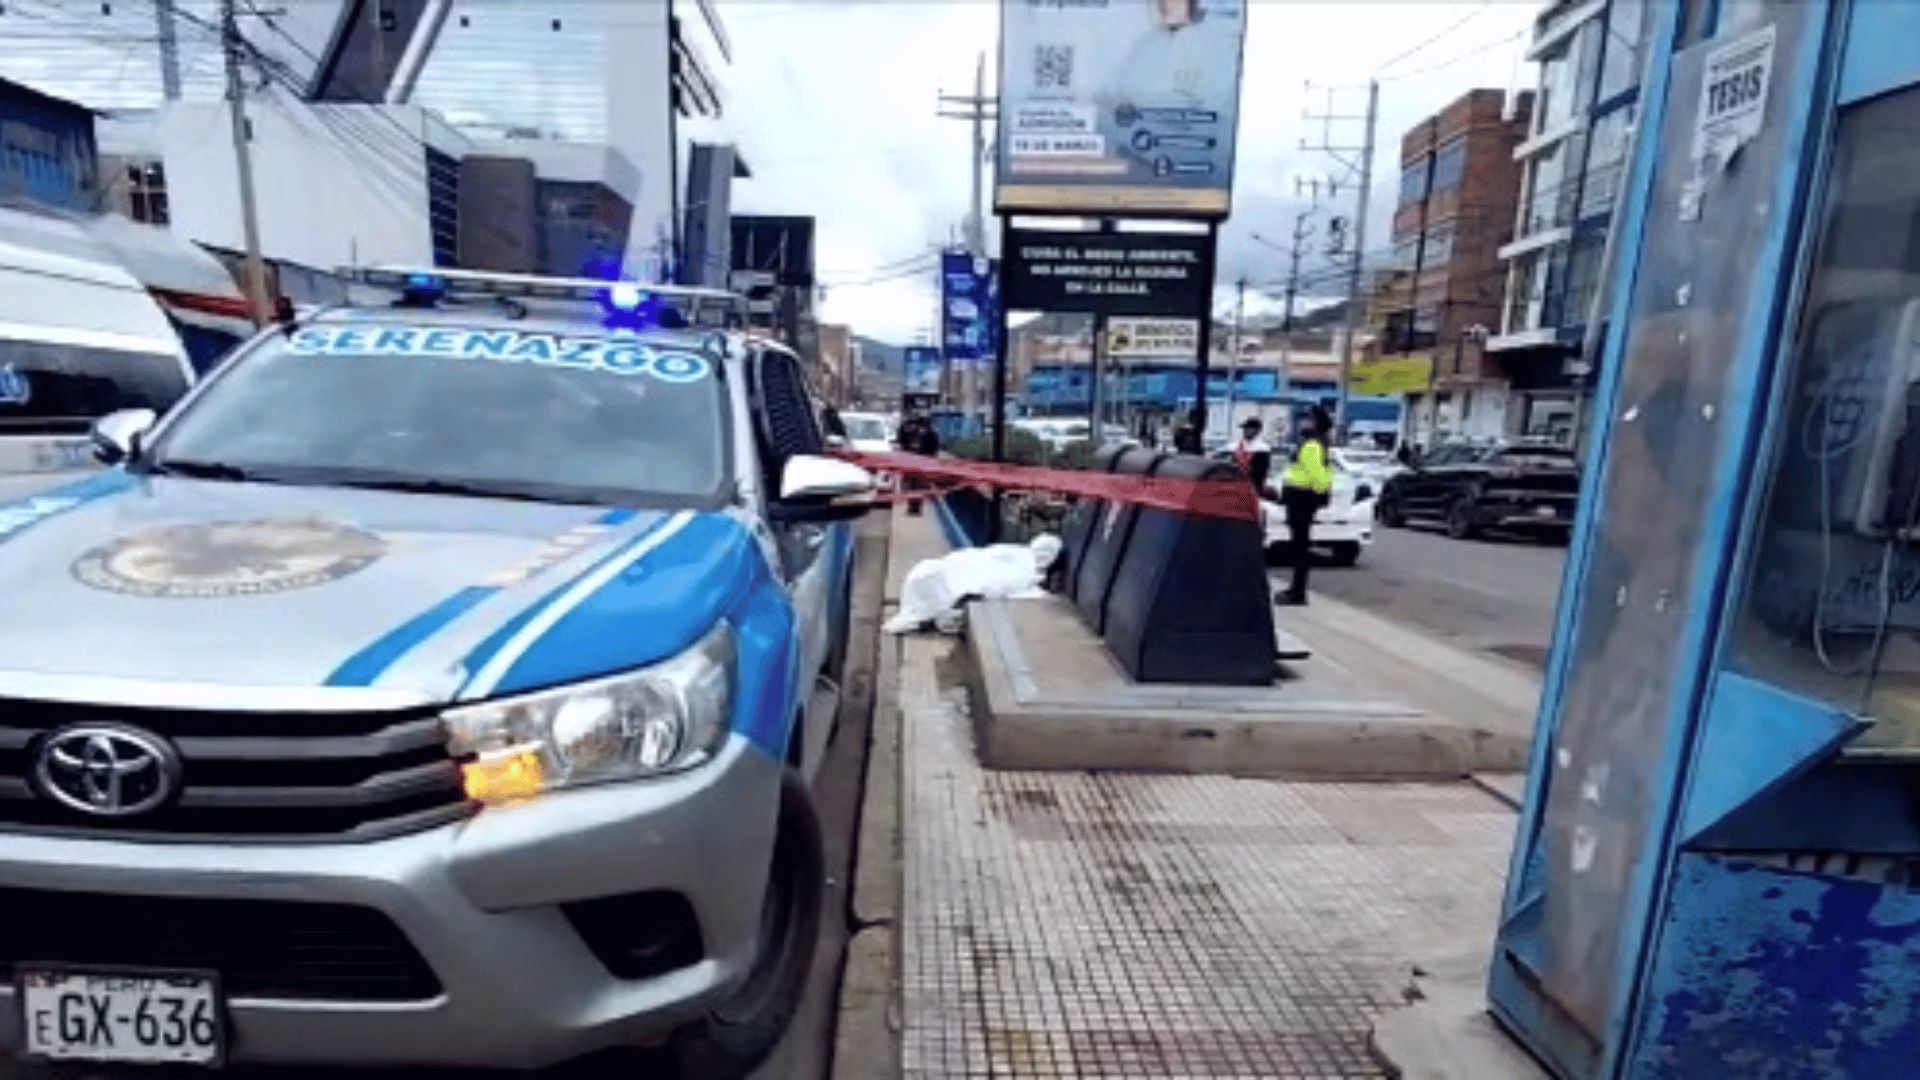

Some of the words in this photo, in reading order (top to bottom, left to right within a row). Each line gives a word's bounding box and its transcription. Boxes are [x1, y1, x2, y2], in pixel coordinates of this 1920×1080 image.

[1708, 65, 1763, 116] TESIS
[291, 328, 708, 382] SERENAZGO
[36, 1010, 51, 1045] E
[59, 994, 215, 1047] GX-636
